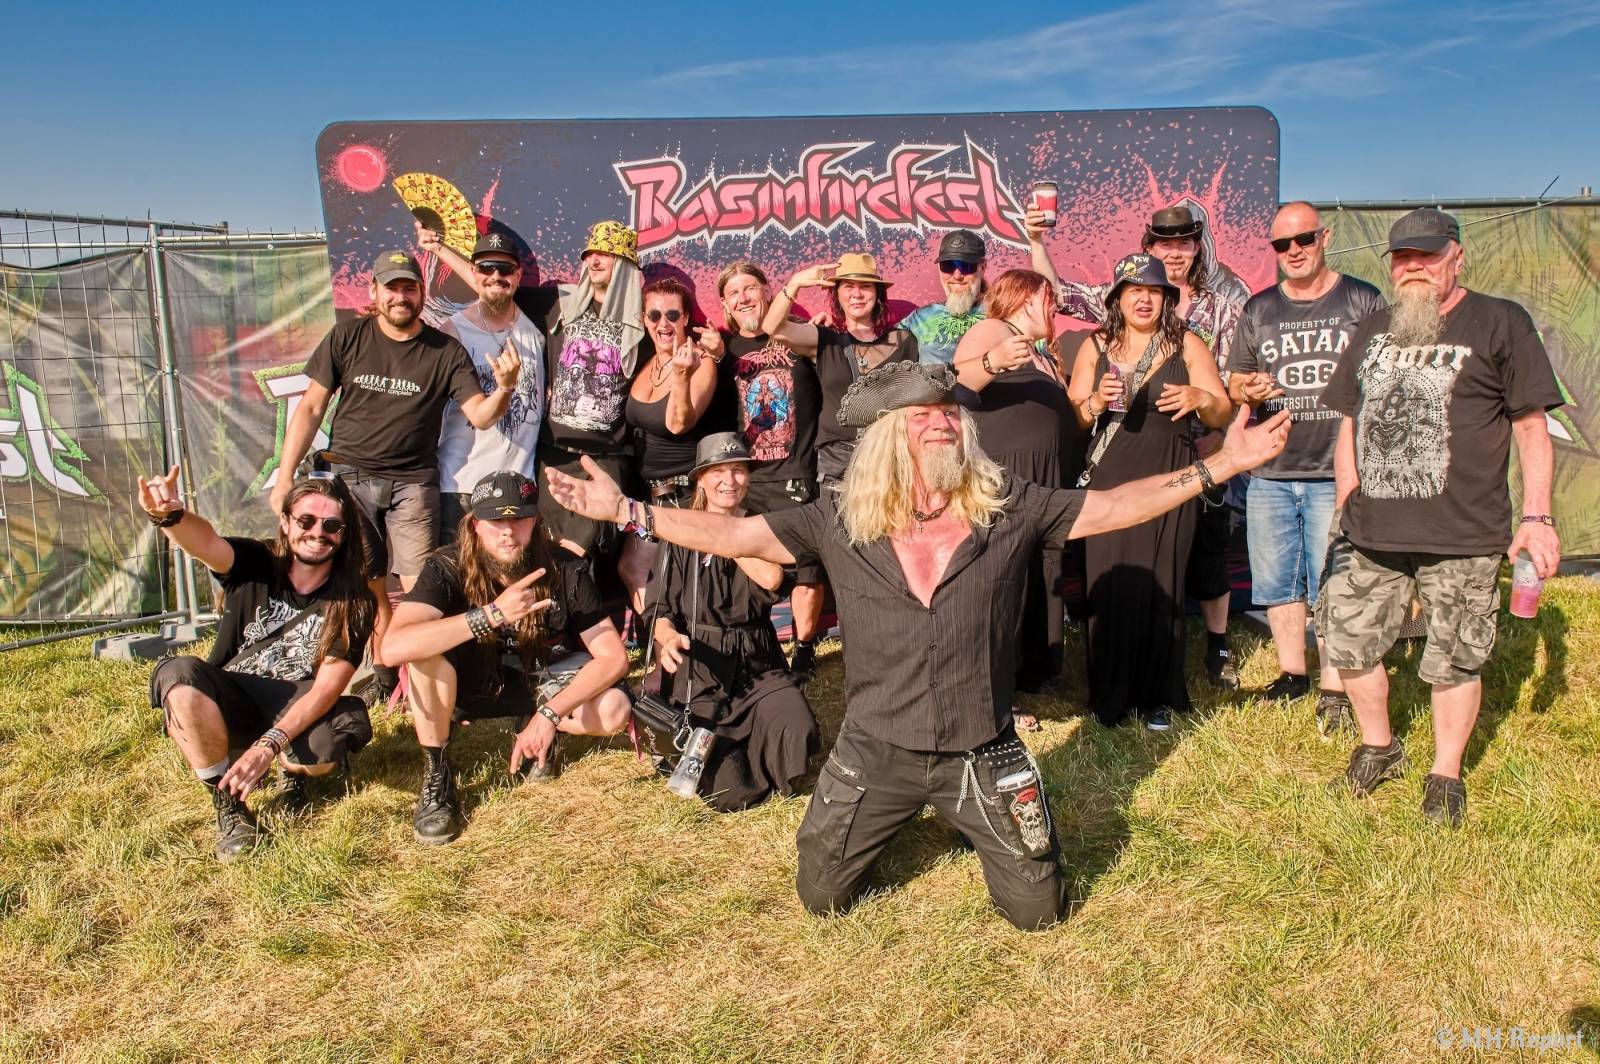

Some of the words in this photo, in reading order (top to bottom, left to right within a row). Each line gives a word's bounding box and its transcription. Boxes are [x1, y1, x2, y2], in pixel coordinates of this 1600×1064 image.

[1279, 319, 1326, 330] PROPERTY
[1329, 317, 1341, 326] OF
[1261, 328, 1350, 363] SATAN
[1285, 362, 1333, 386] 666
[1265, 395, 1319, 411] UNIVERSITY
[1300, 411, 1314, 421] FOR
